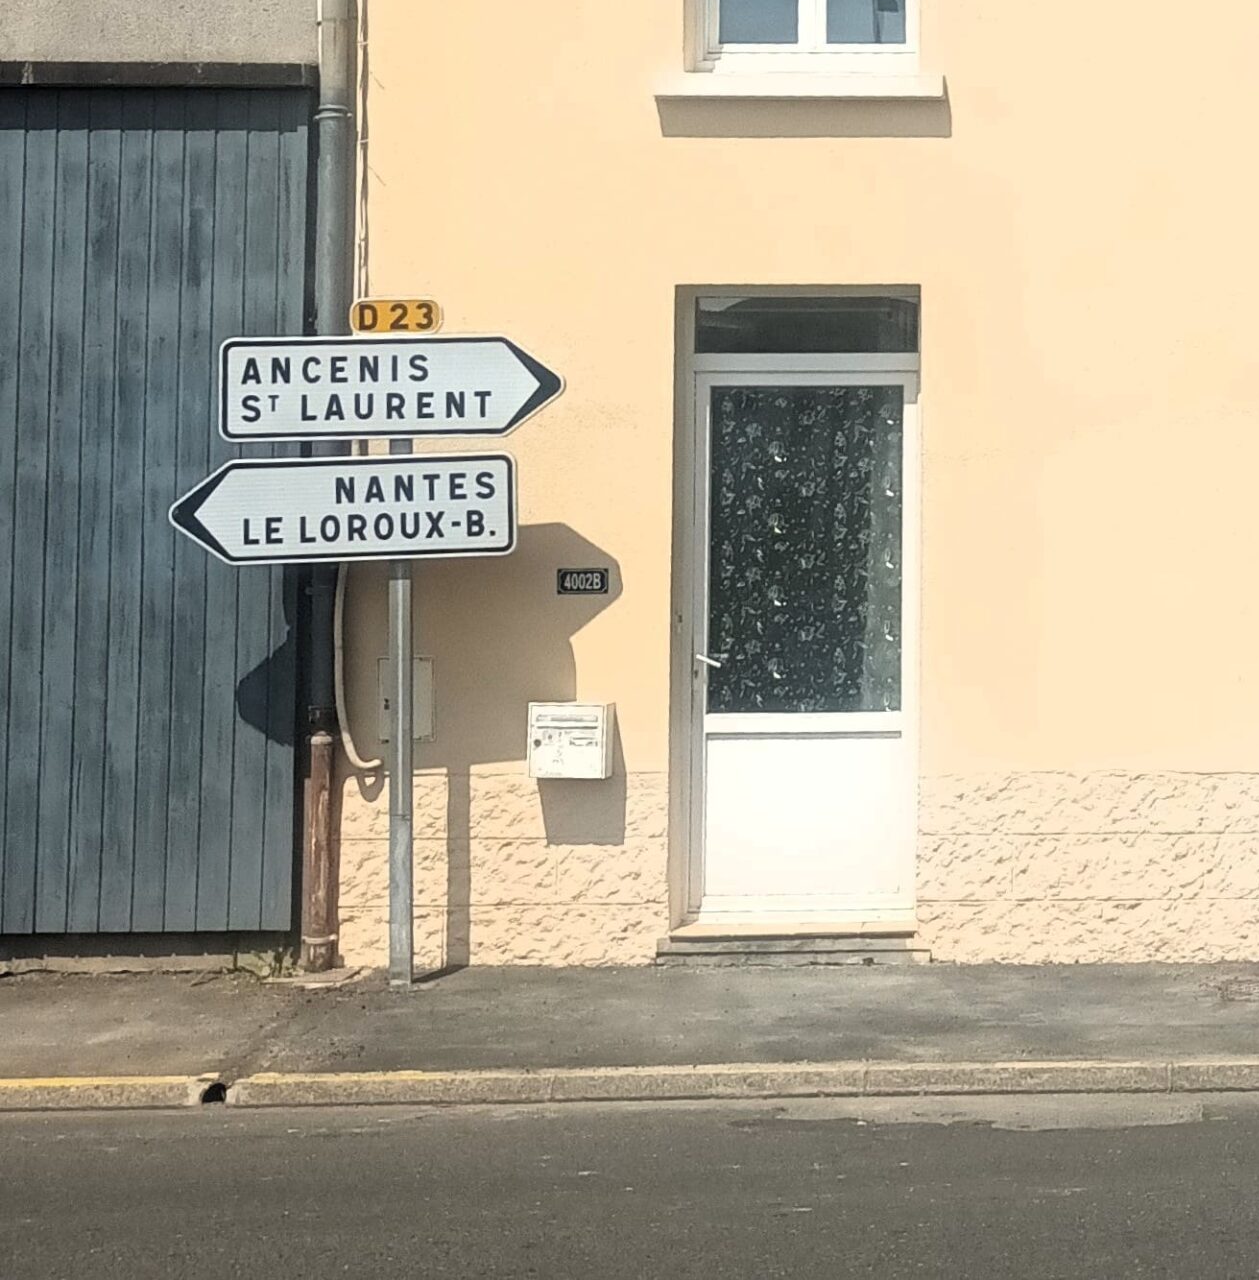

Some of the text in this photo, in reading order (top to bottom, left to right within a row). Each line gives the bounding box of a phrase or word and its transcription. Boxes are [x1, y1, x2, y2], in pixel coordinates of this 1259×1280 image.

[358, 303, 434, 330] D 23
[241, 354, 429, 385] ANCENIS
[301, 391, 492, 421] LAURENT
[335, 471, 496, 504] NANTES
[243, 509, 497, 545] LE LOROUX-B.
[564, 573, 602, 590] 4002B
